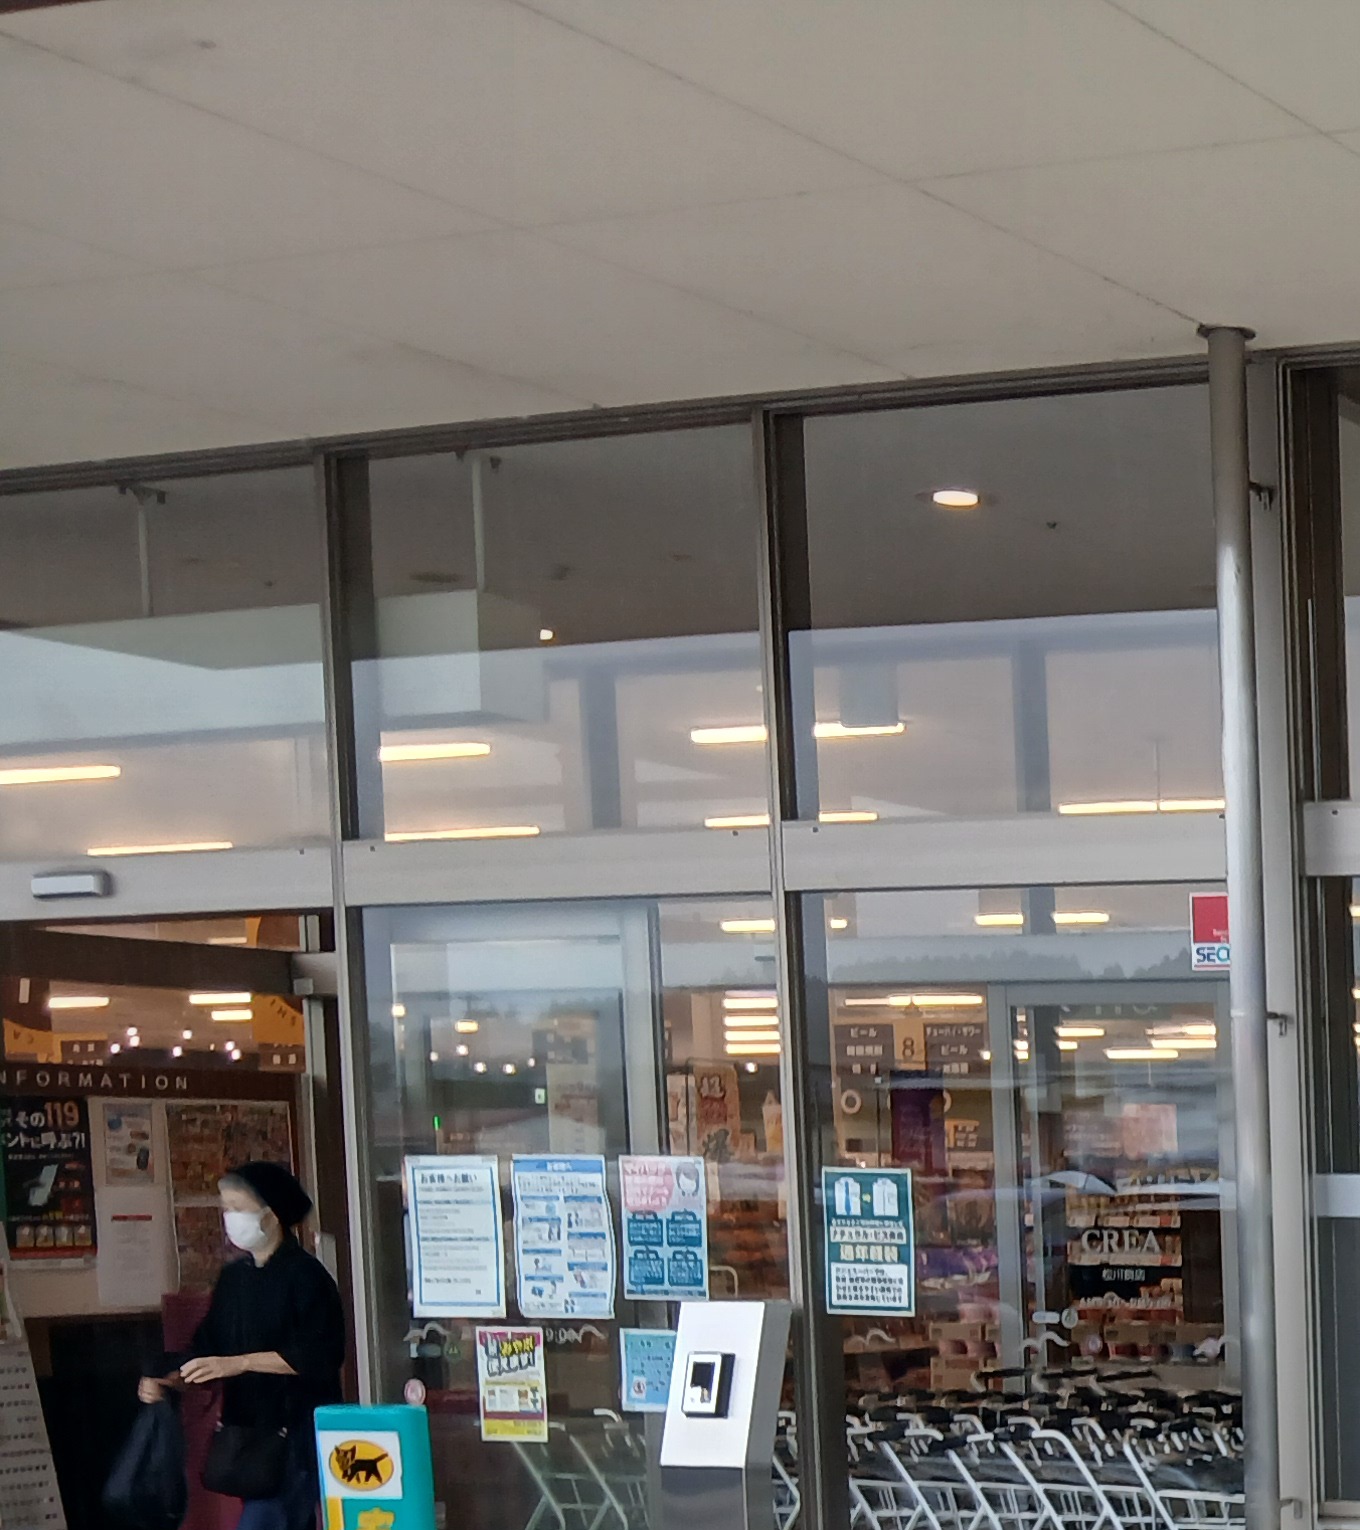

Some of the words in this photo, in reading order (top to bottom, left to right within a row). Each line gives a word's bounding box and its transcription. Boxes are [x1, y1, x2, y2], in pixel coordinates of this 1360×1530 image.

[1195, 946, 1230, 963] SEC
[850, 1027, 877, 1038] ビール
[902, 1037, 915, 1059] 8
[1081, 1229, 1161, 1253] CREA
